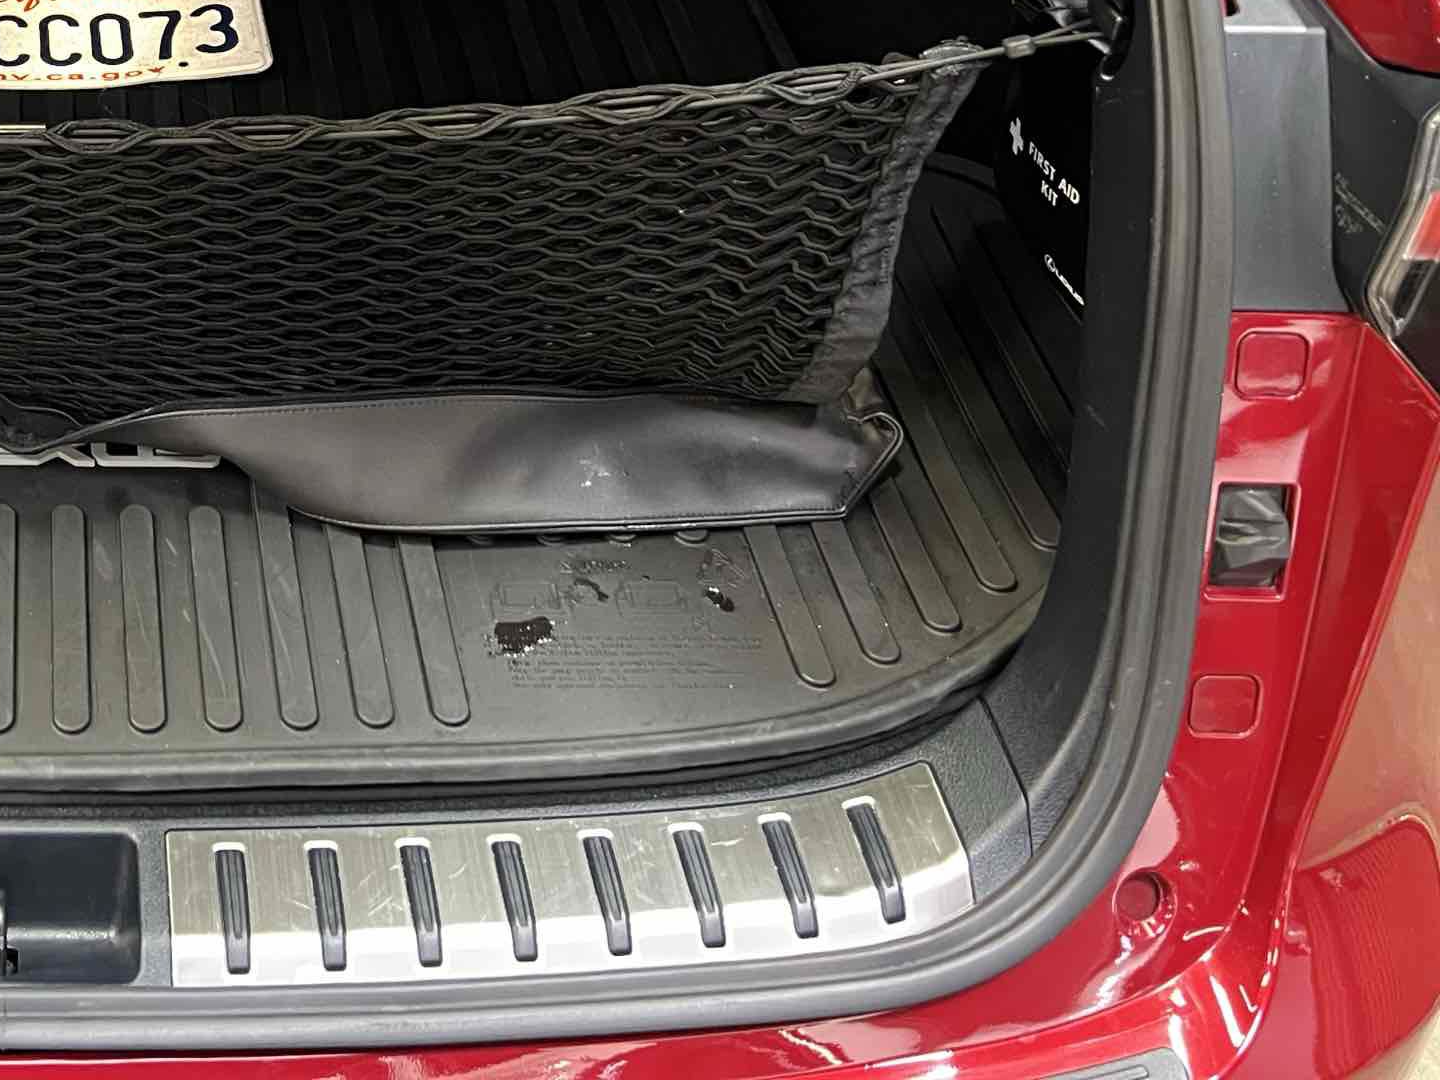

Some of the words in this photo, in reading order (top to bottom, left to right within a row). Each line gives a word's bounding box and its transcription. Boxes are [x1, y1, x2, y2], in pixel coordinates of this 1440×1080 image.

[1029, 141, 1056, 181] FIRST
[1058, 178, 1080, 204] AID
[1041, 180, 1058, 206] KIT
